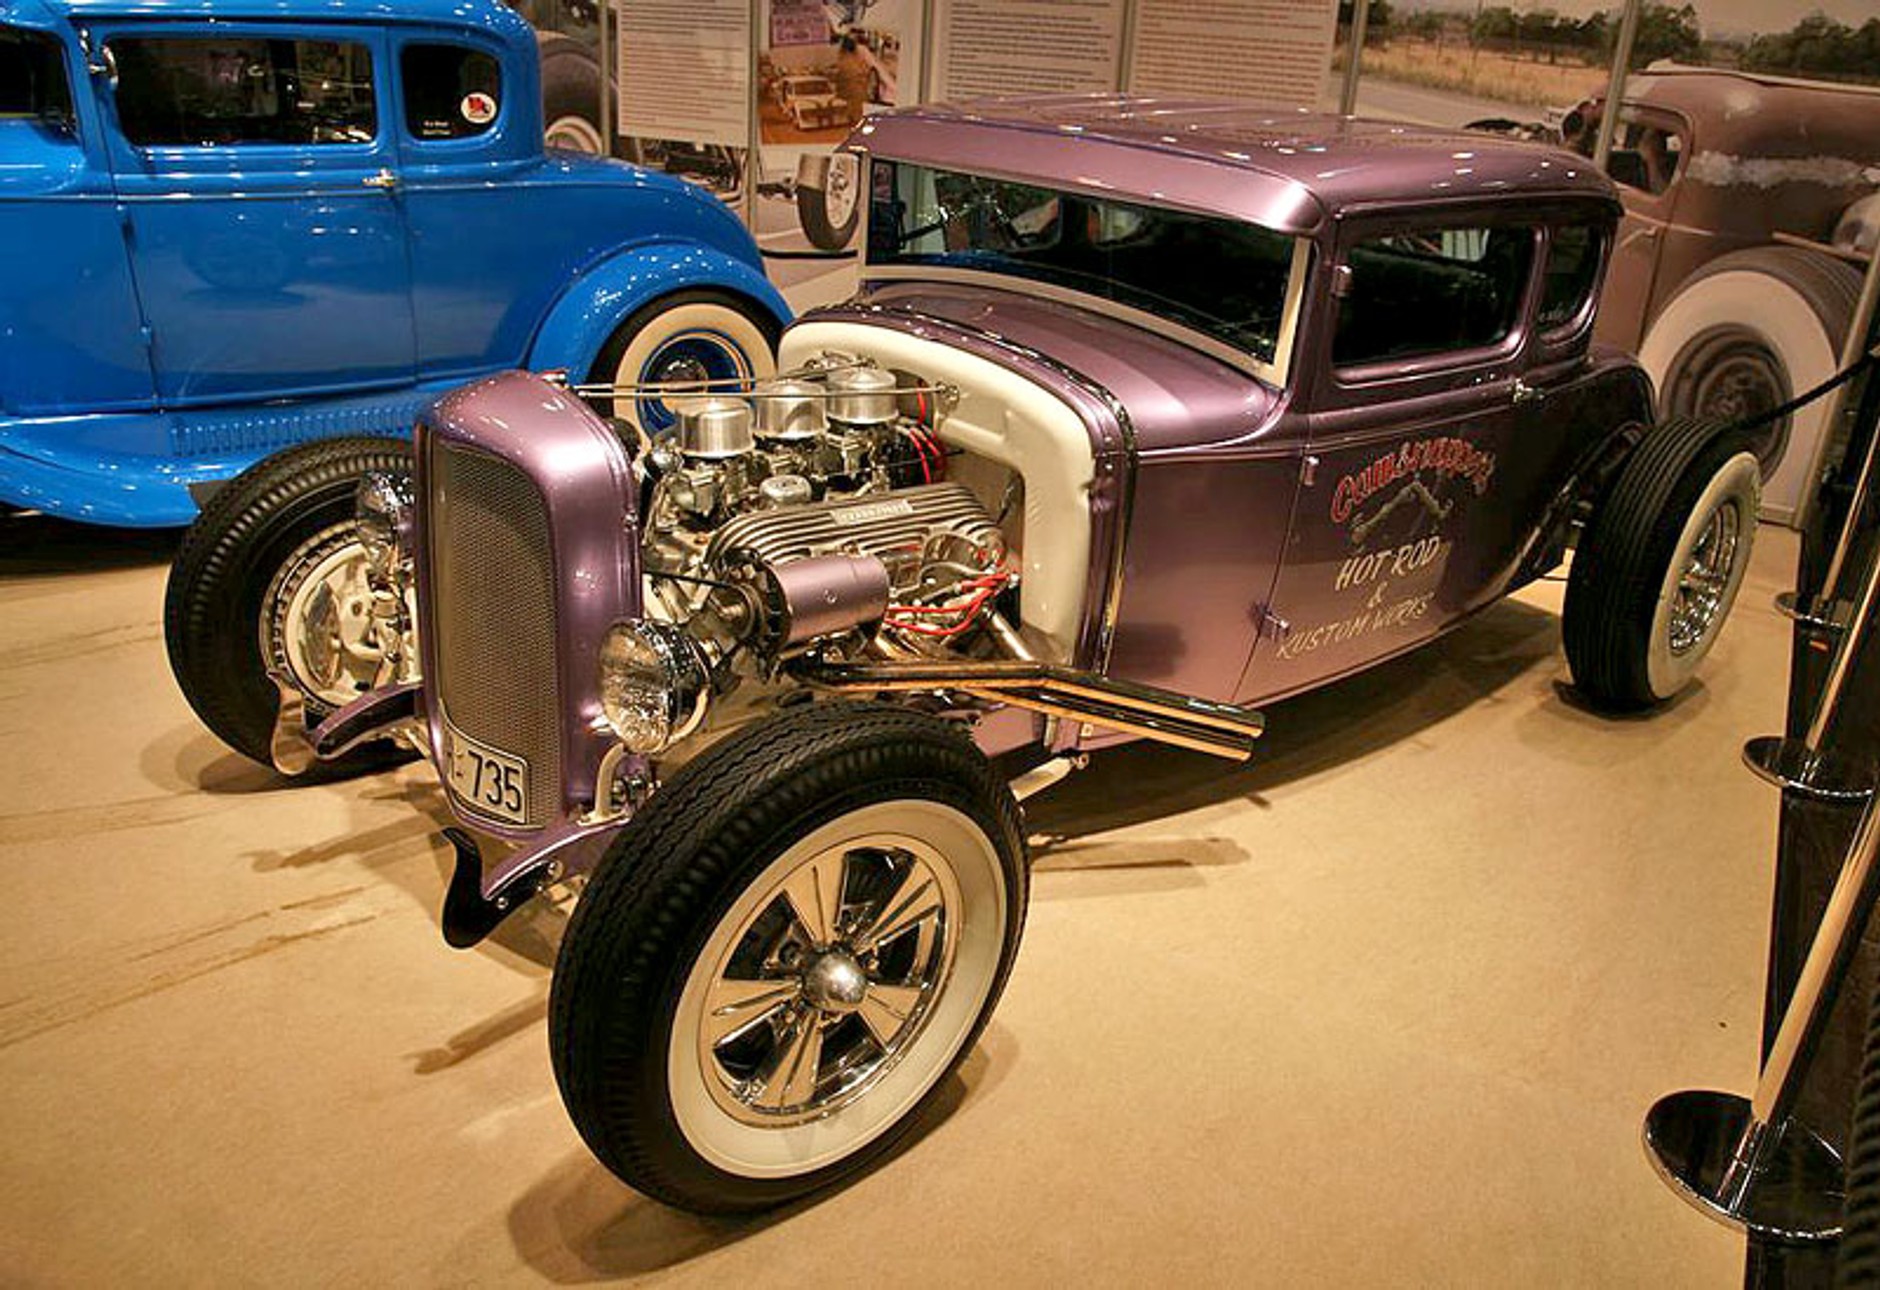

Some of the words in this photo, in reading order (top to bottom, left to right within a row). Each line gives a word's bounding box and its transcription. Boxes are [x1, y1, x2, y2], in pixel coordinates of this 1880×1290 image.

[1336, 550, 1391, 591] HOT
[1392, 536, 1440, 577] ROD
[1368, 582, 1388, 609] &
[1276, 613, 1369, 660] KUSTOM
[467, 749, 521, 812] 735
